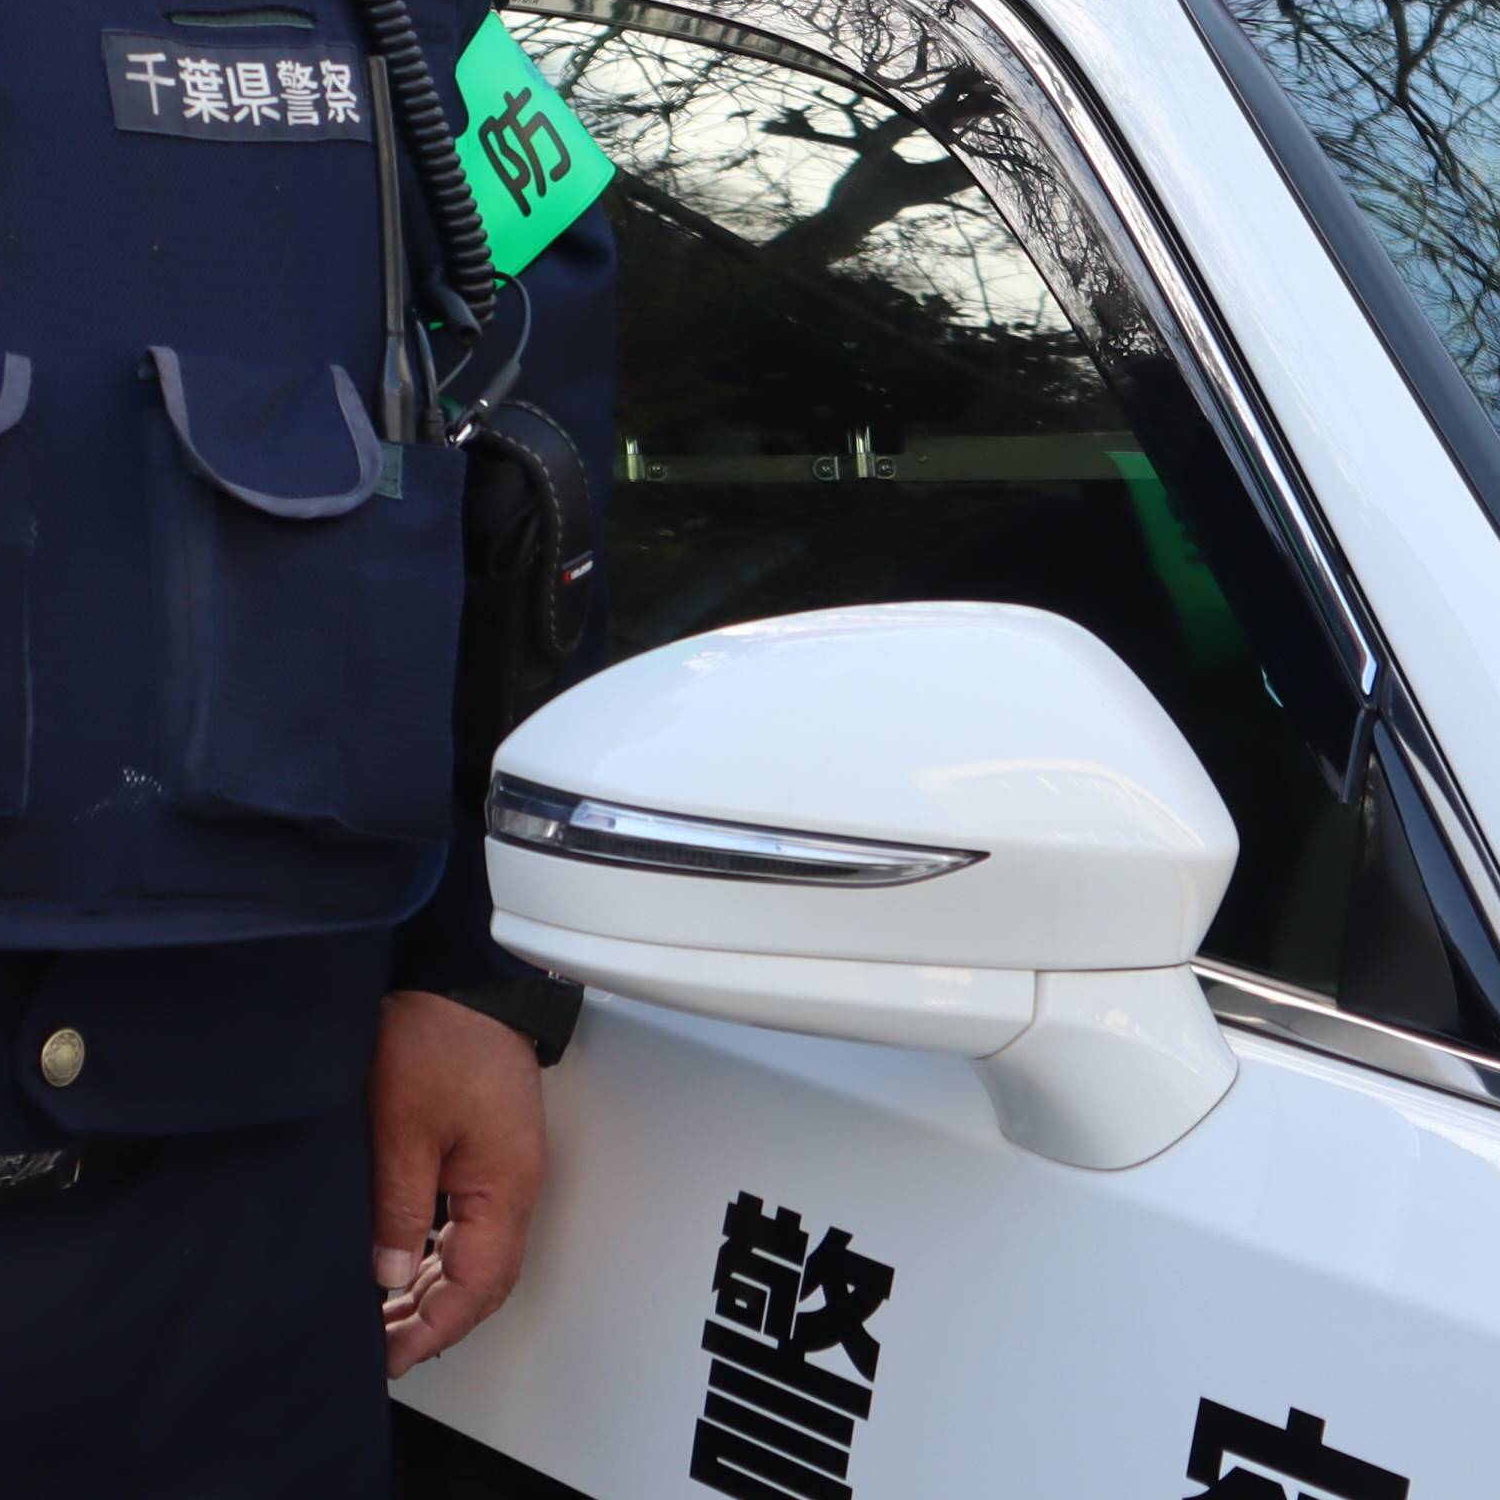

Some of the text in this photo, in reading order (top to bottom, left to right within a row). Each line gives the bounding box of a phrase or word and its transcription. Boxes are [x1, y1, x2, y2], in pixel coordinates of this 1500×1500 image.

[124, 51, 361, 127] 千葉県警察
[478, 86, 572, 218] 防
